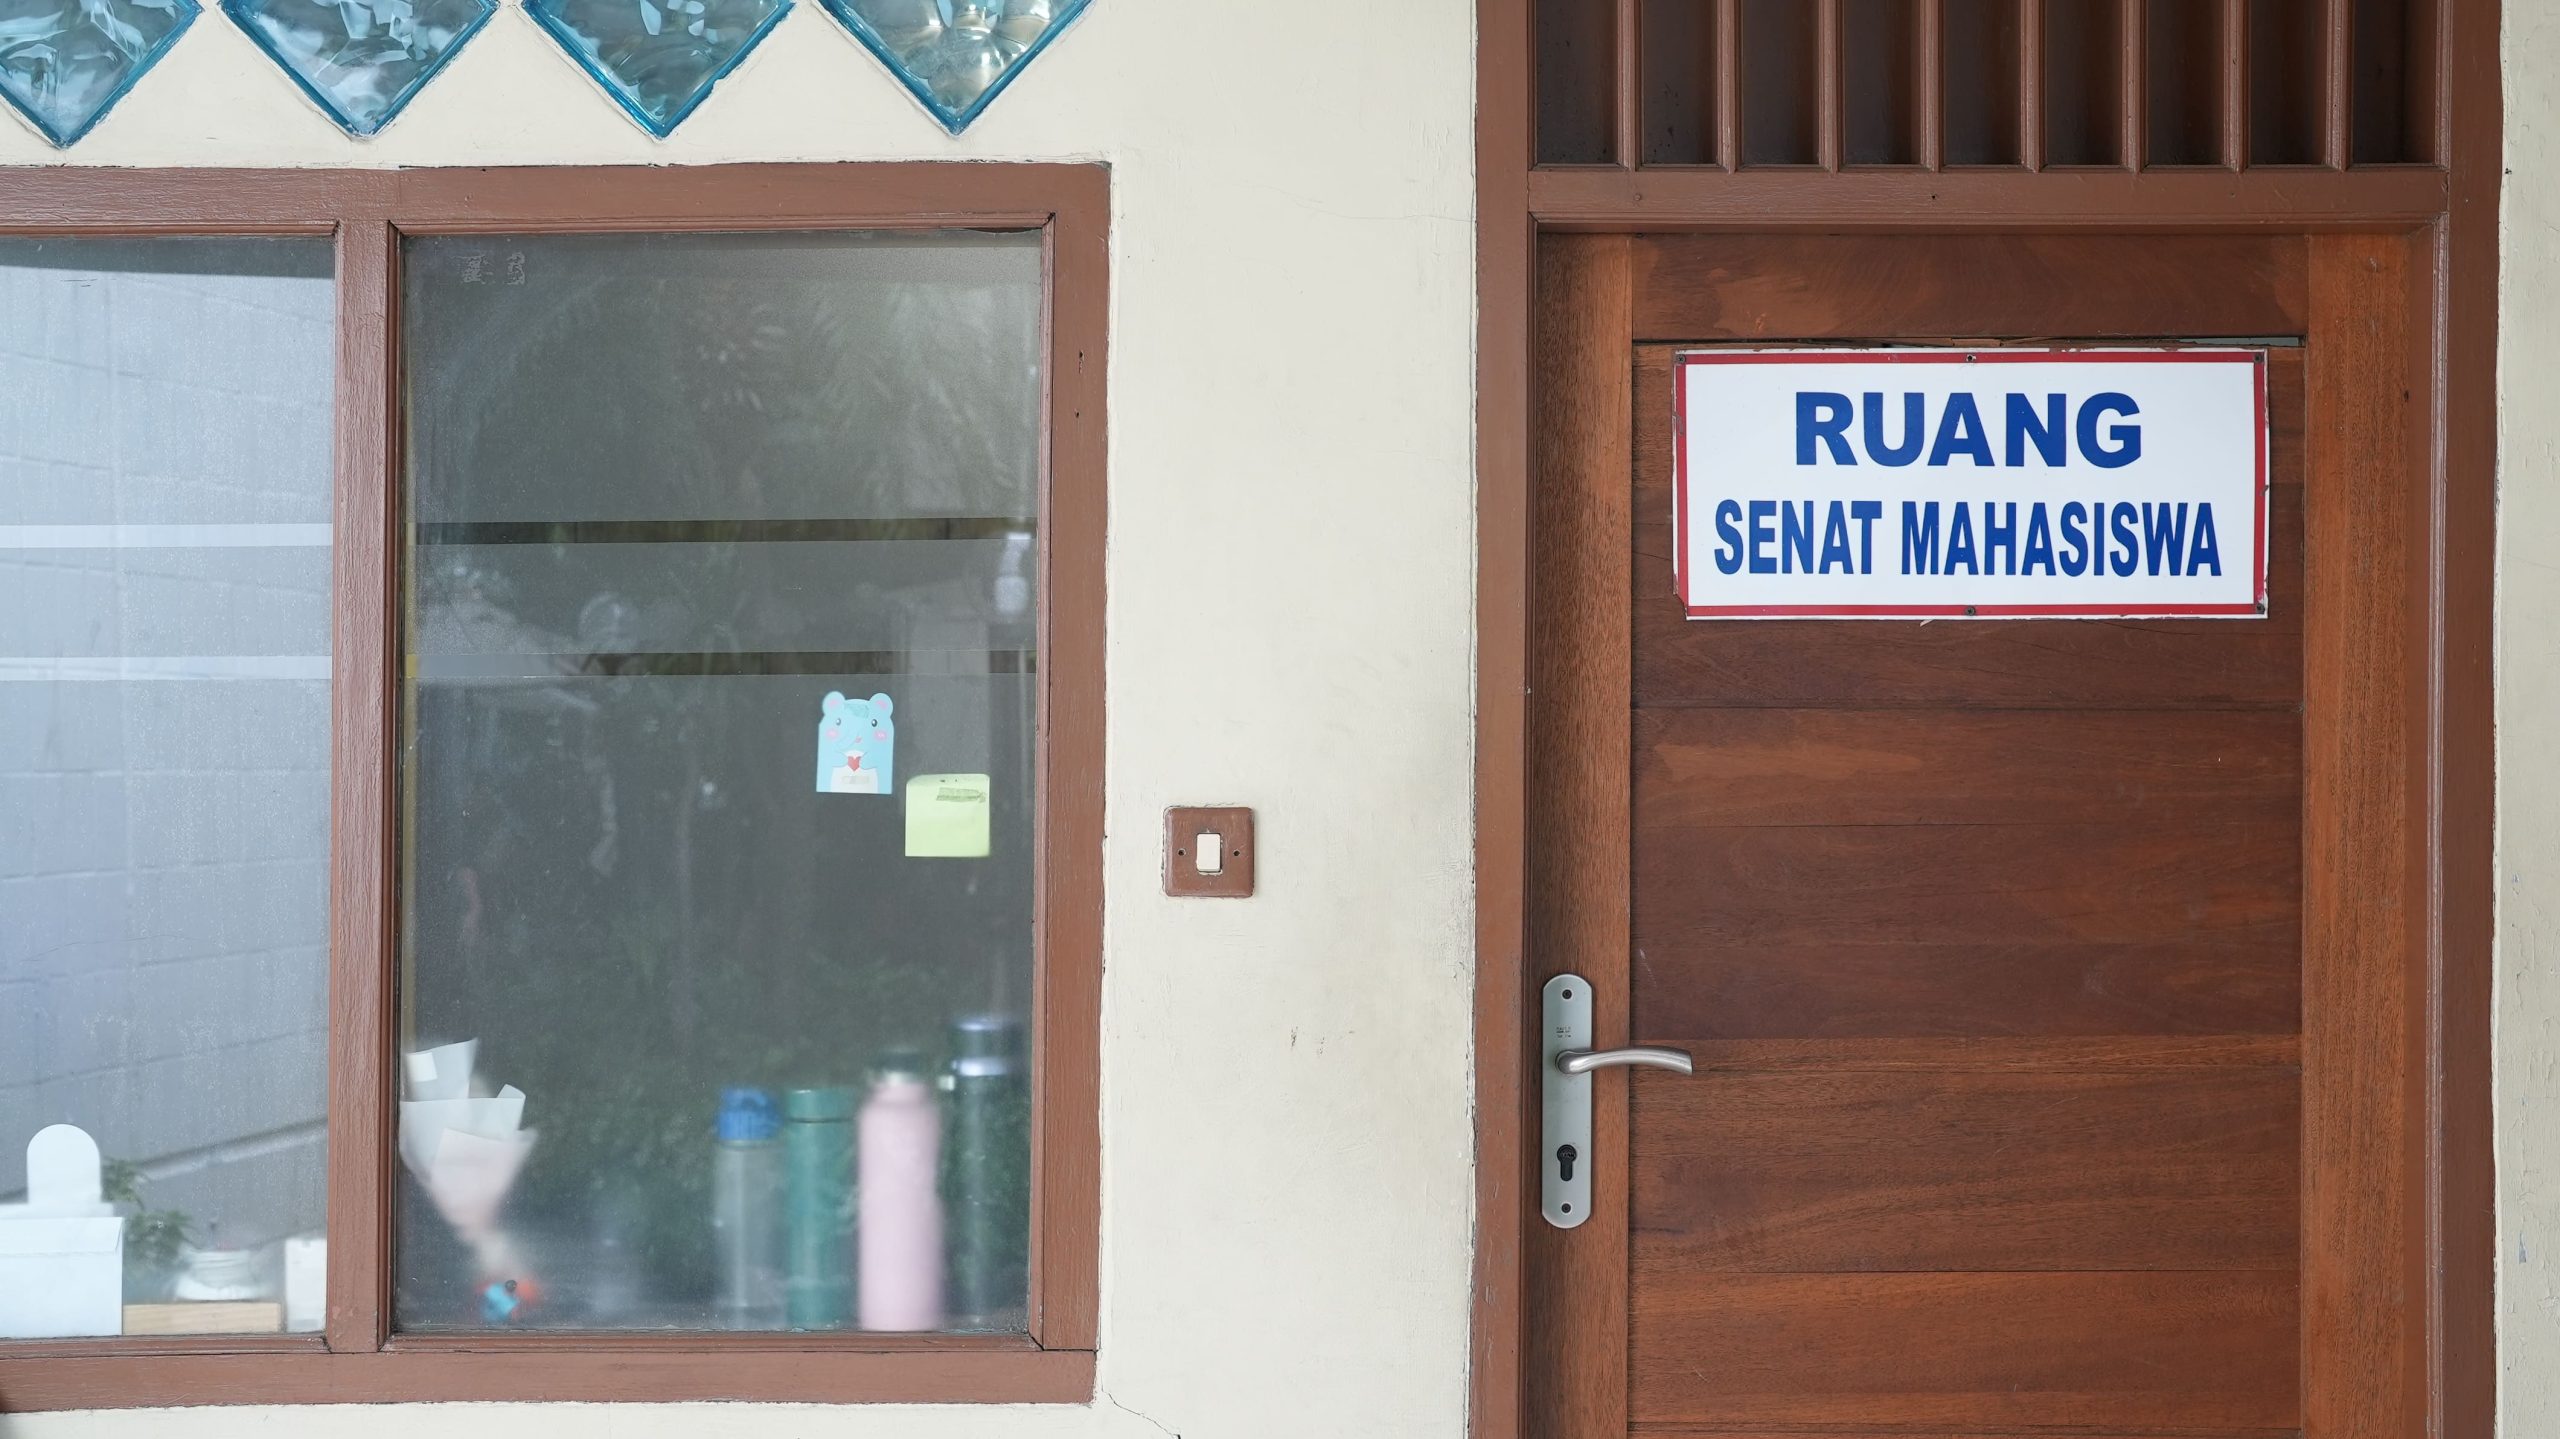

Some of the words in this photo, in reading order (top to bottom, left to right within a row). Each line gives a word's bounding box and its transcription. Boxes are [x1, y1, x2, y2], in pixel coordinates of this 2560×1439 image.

[1795, 391, 2142, 469] RUANG
[1714, 499, 1882, 575] SENAT
[1901, 501, 2222, 577] MAHASISWA
